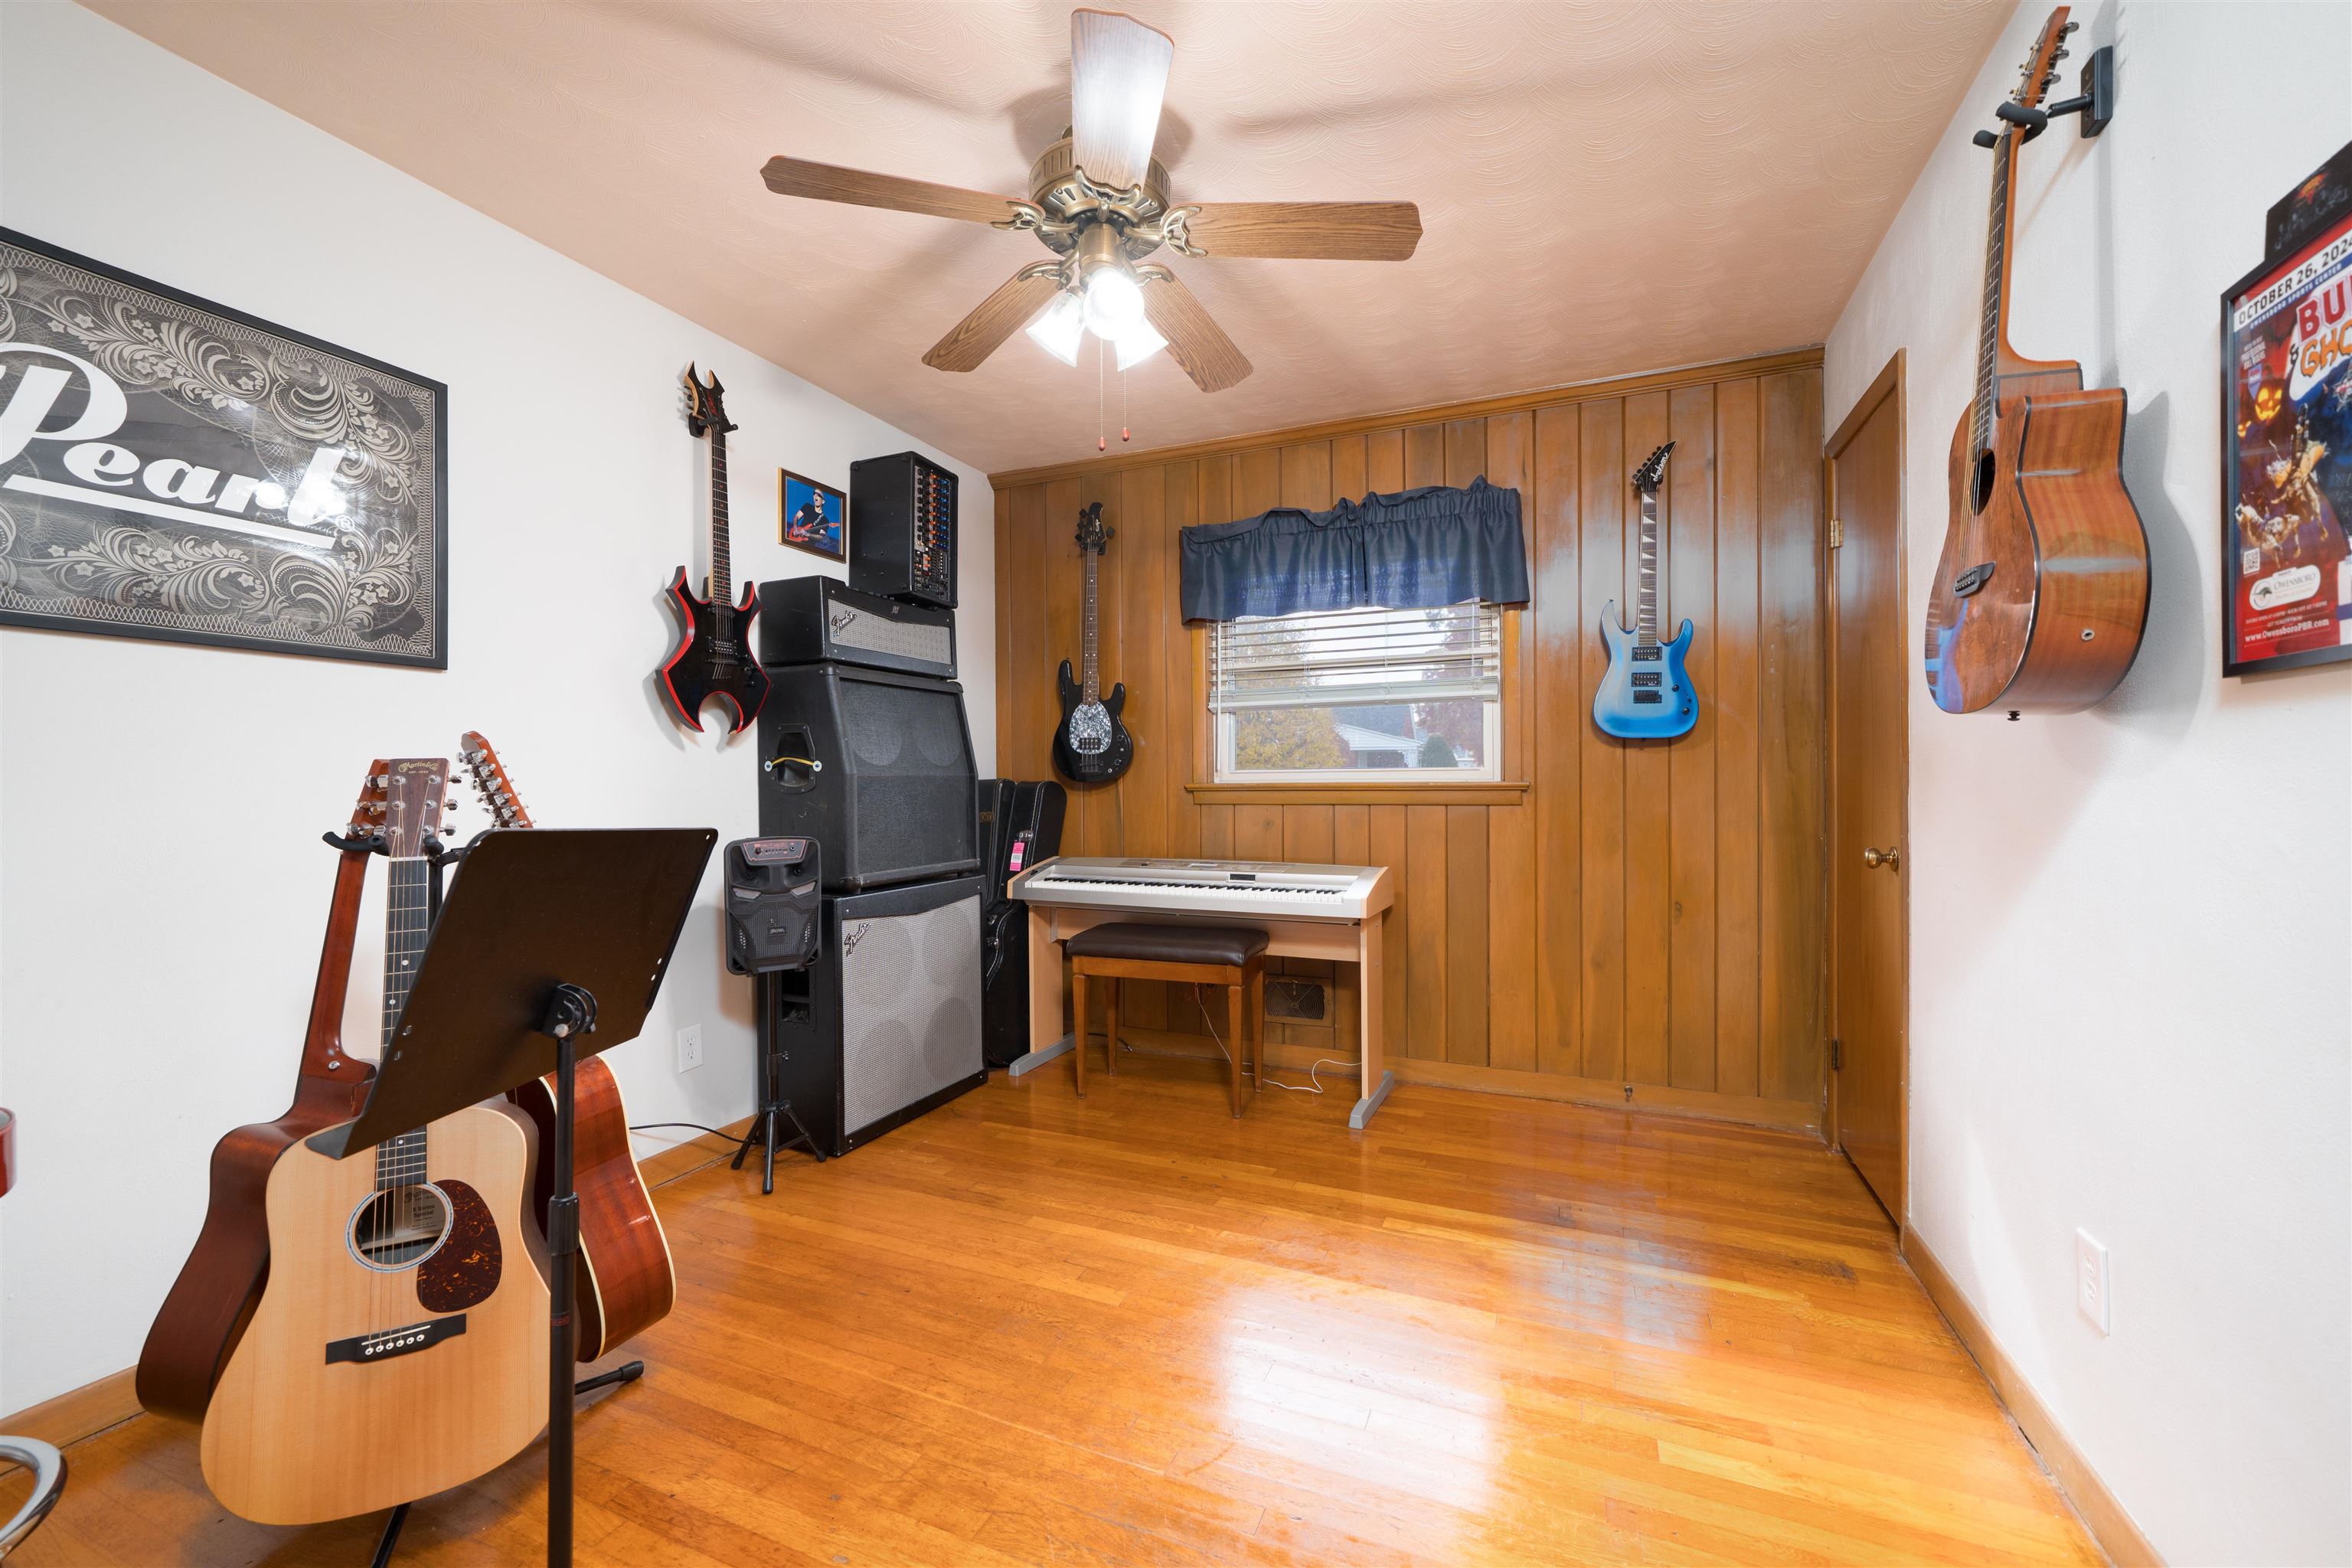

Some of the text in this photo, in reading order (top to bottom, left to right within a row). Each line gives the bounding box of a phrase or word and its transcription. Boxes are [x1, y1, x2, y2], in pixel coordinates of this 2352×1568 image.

[2239, 277, 2292, 325] OCTOBER
[2297, 263, 2318, 286] 26,
[2288, 283, 2313, 303] SPORTS
[2314, 263, 2342, 286] CENTER
[2298, 276, 2352, 342] BU
[0, 341, 345, 527] Pearl
[1651, 452, 1668, 482] Jackson
[831, 610, 858, 637] Fender
[2245, 619, 2330, 642] www.OwensboroPBR.com
[844, 923, 871, 957] Fender
